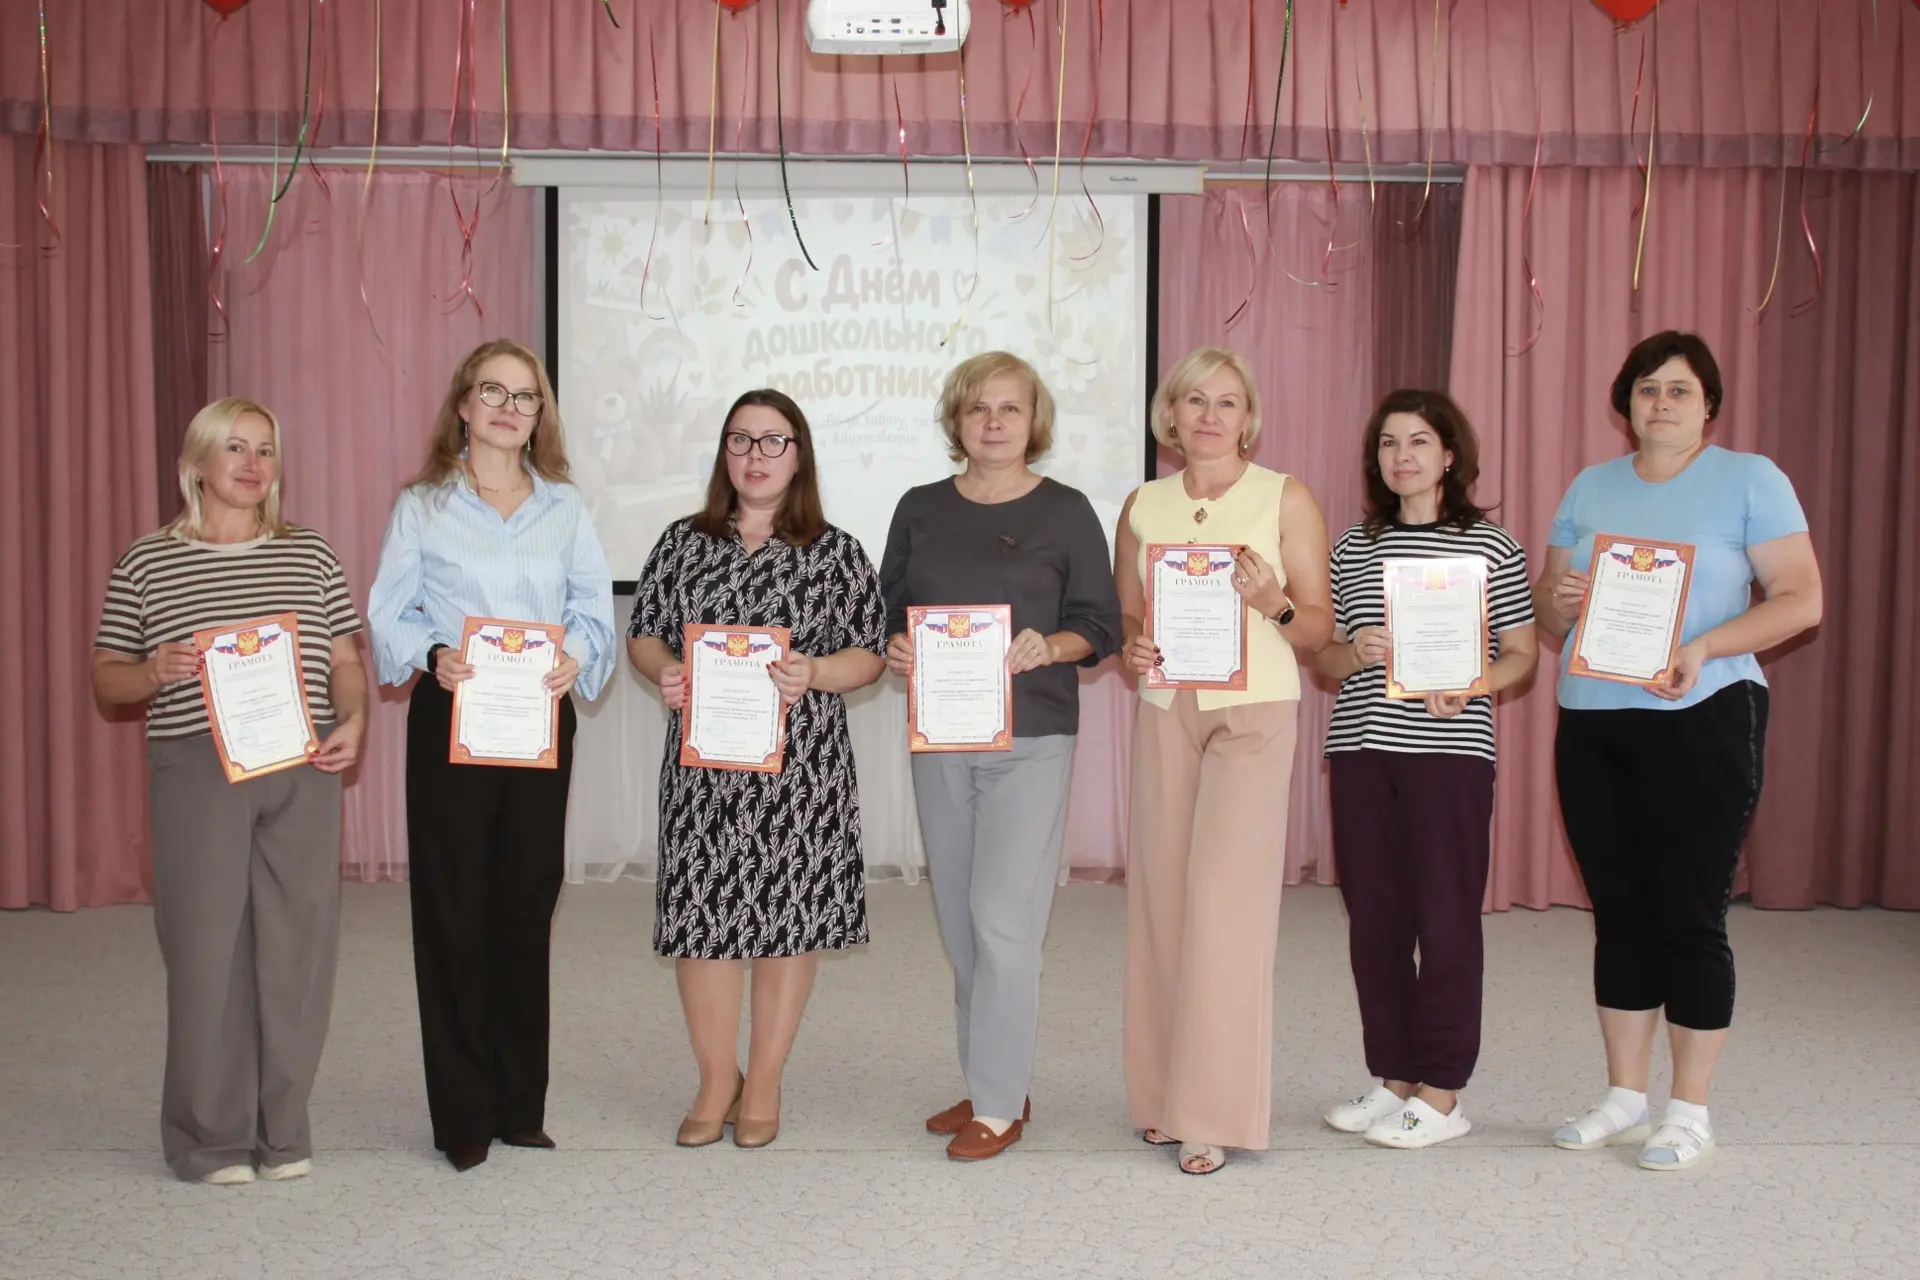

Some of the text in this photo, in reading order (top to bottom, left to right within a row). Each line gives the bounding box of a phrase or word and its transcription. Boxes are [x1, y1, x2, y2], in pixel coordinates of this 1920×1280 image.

[774, 253, 941, 314] С Днём
[741, 317, 989, 372] дошкольного
[766, 357, 945, 402] работник
[1175, 577, 1221, 587] ГРАМОТА
[1616, 570, 1663, 584] ГРАМОТА
[936, 640, 983, 649] ГРАМОТА
[227, 654, 274, 671] ГРАМОТА
[487, 652, 533, 664] ГРАМОТА
[714, 658, 761, 669] ГРАМОТА
